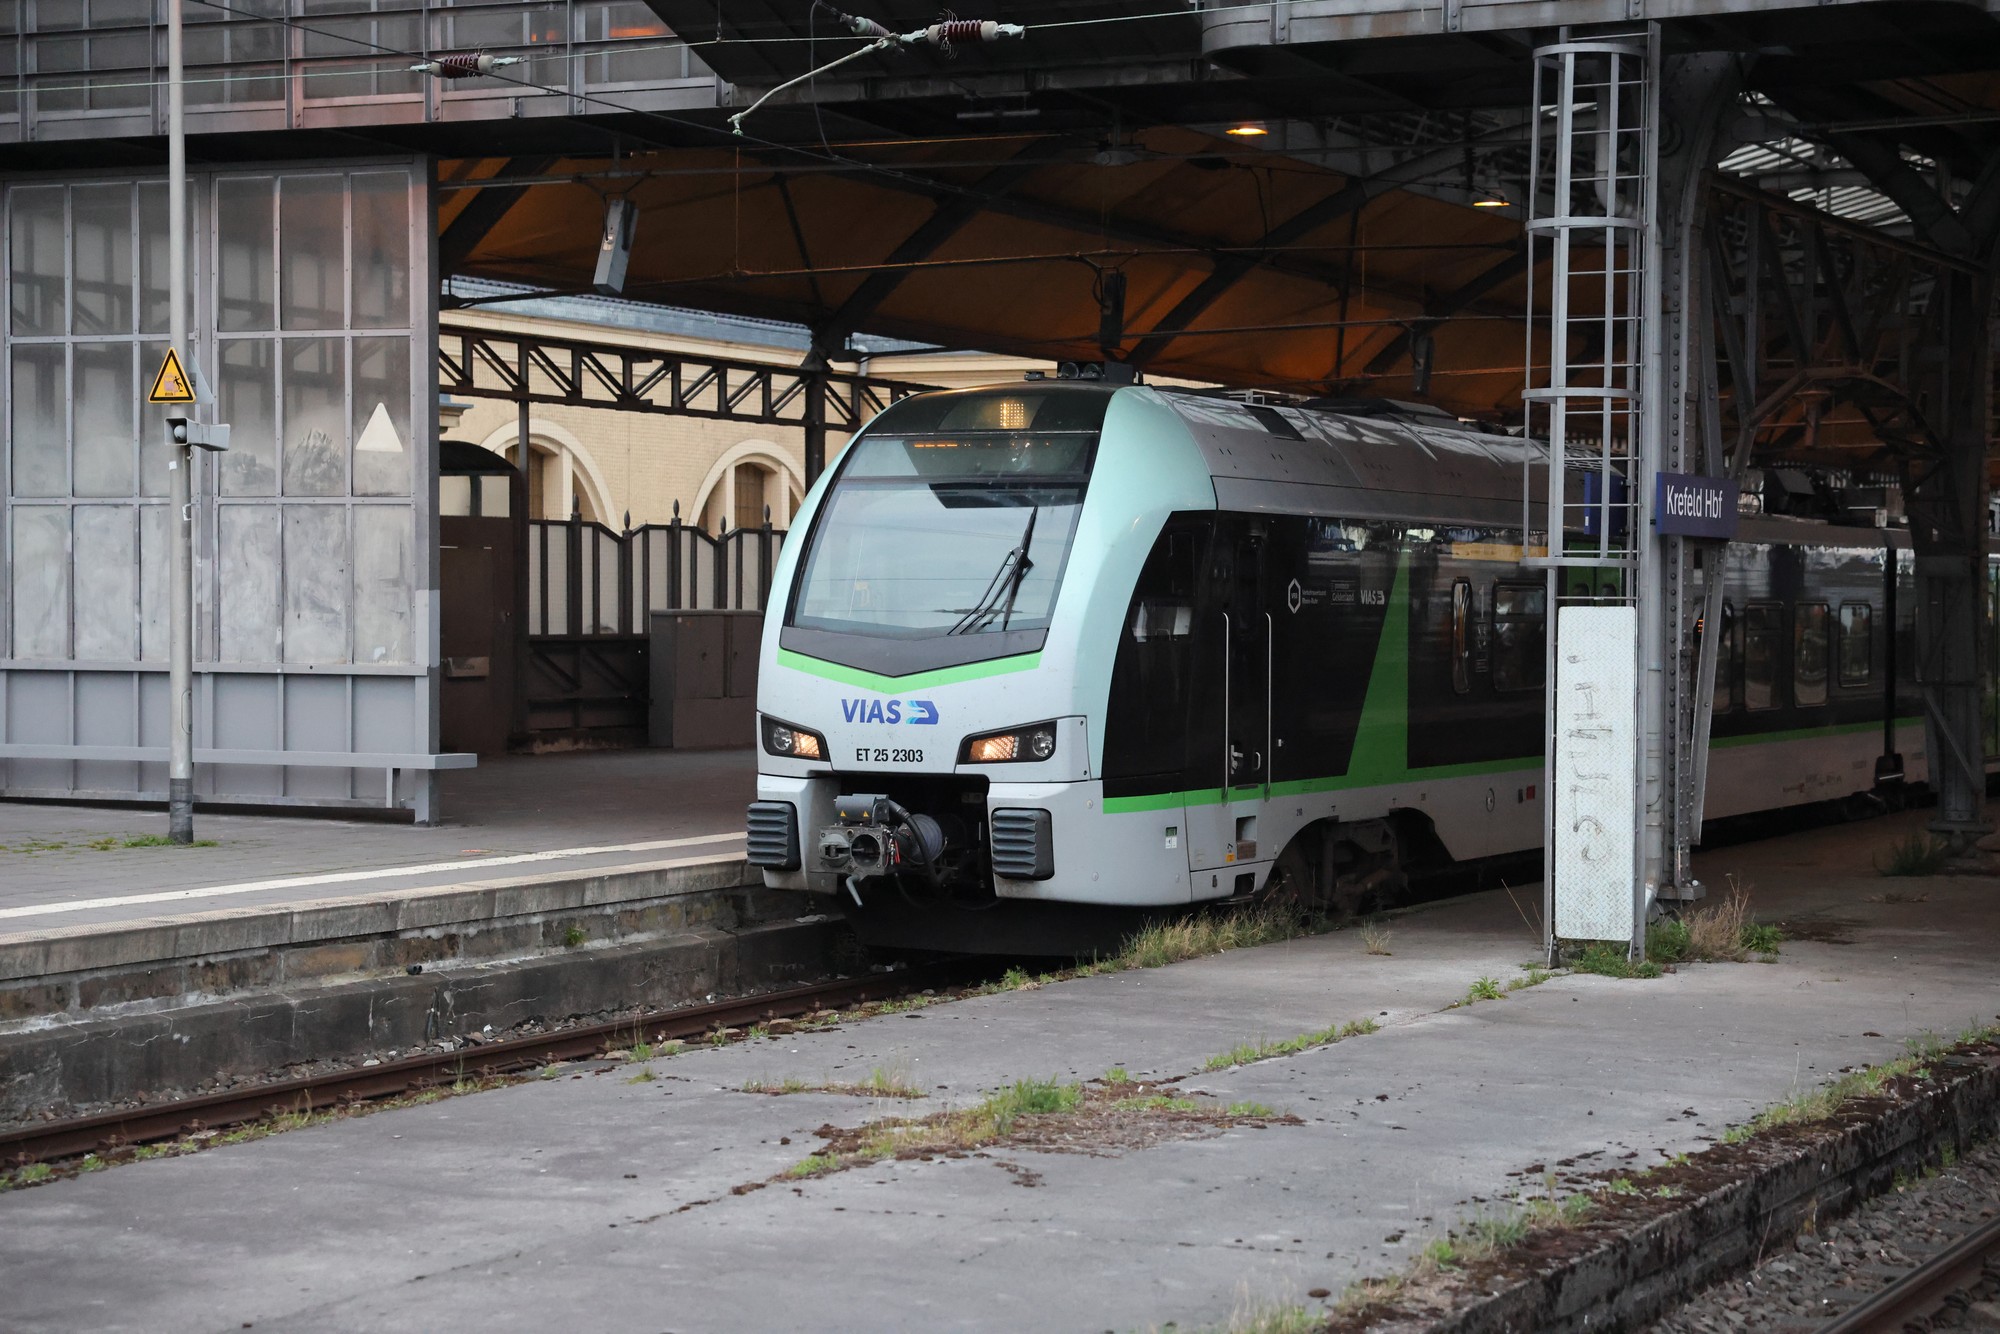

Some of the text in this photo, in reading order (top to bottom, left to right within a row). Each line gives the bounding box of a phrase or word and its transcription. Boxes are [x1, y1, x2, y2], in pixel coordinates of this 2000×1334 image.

[1666, 485, 1723, 518] Krefeld Hbf
[1360, 589, 1376, 605] VIAS
[841, 699, 901, 724] VIAS
[856, 748, 924, 762] ET 25 2303
